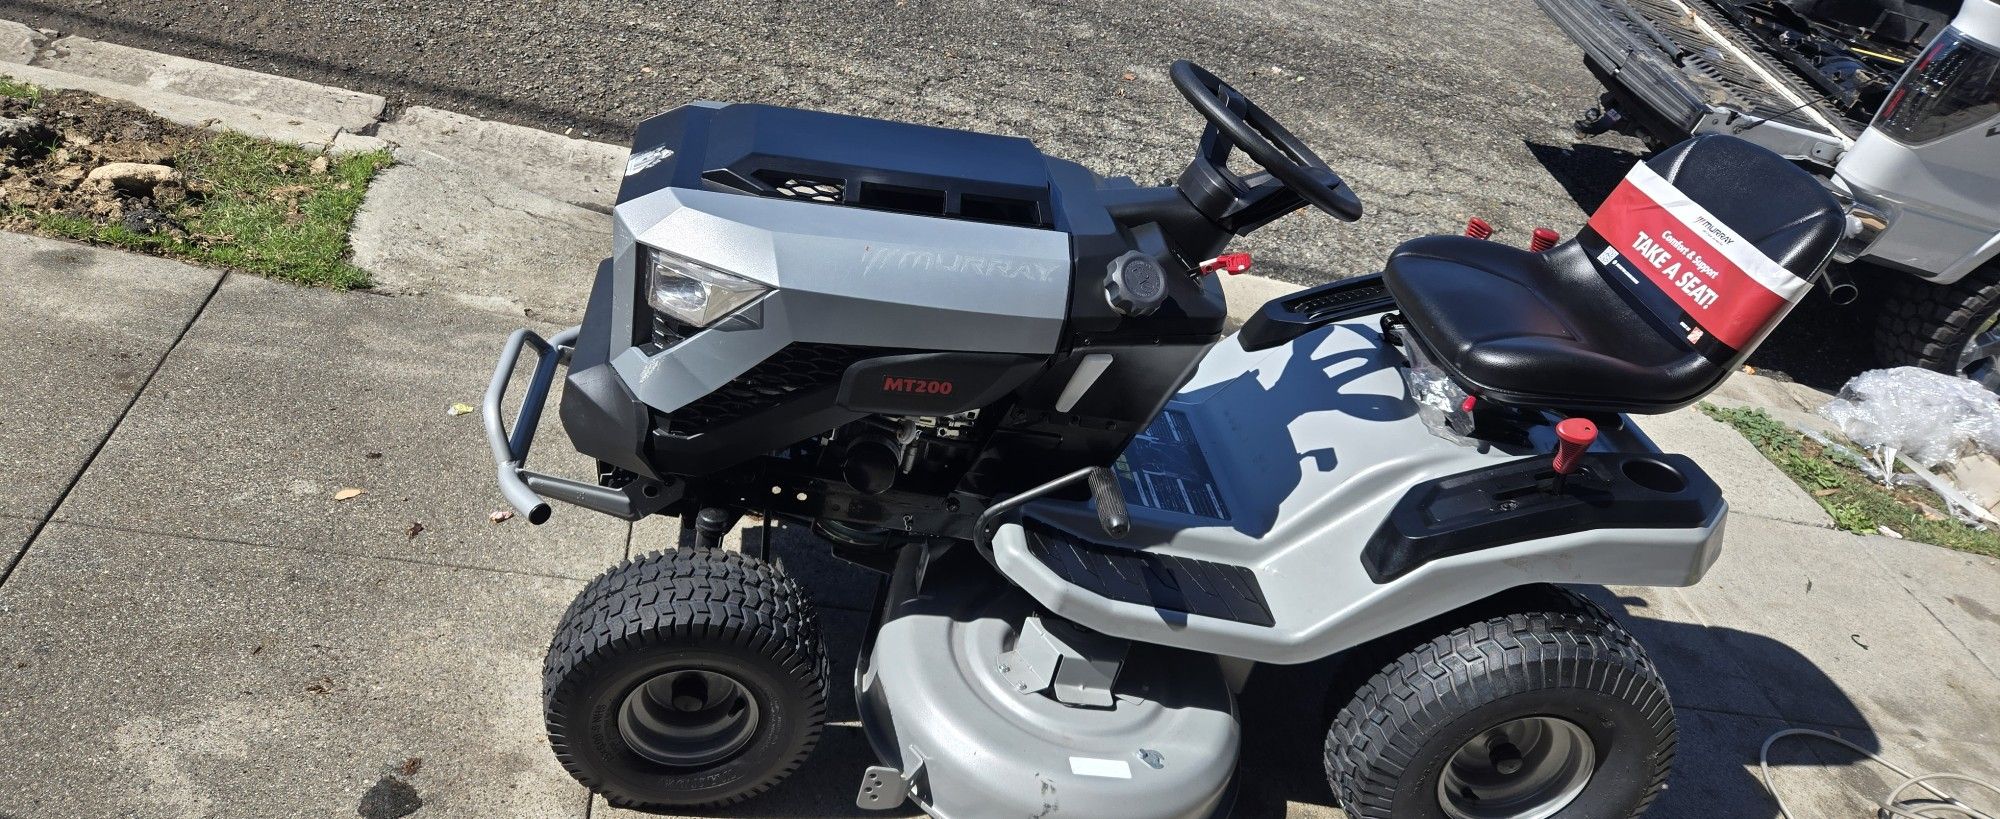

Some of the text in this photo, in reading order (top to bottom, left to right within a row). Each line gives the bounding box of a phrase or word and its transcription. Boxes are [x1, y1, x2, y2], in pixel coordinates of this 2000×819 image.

[1702, 220, 1735, 245] MURRAY
[897, 248, 1061, 282] MURRAY
[1632, 230, 1672, 269] TAKE
[1661, 262, 1682, 281] A
[1674, 271, 1719, 310] SEAT!
[1661, 230, 1690, 256] Comfort
[1686, 250, 1697, 261] &
[1692, 255, 1719, 279] Support
[884, 376, 953, 395] MT200
